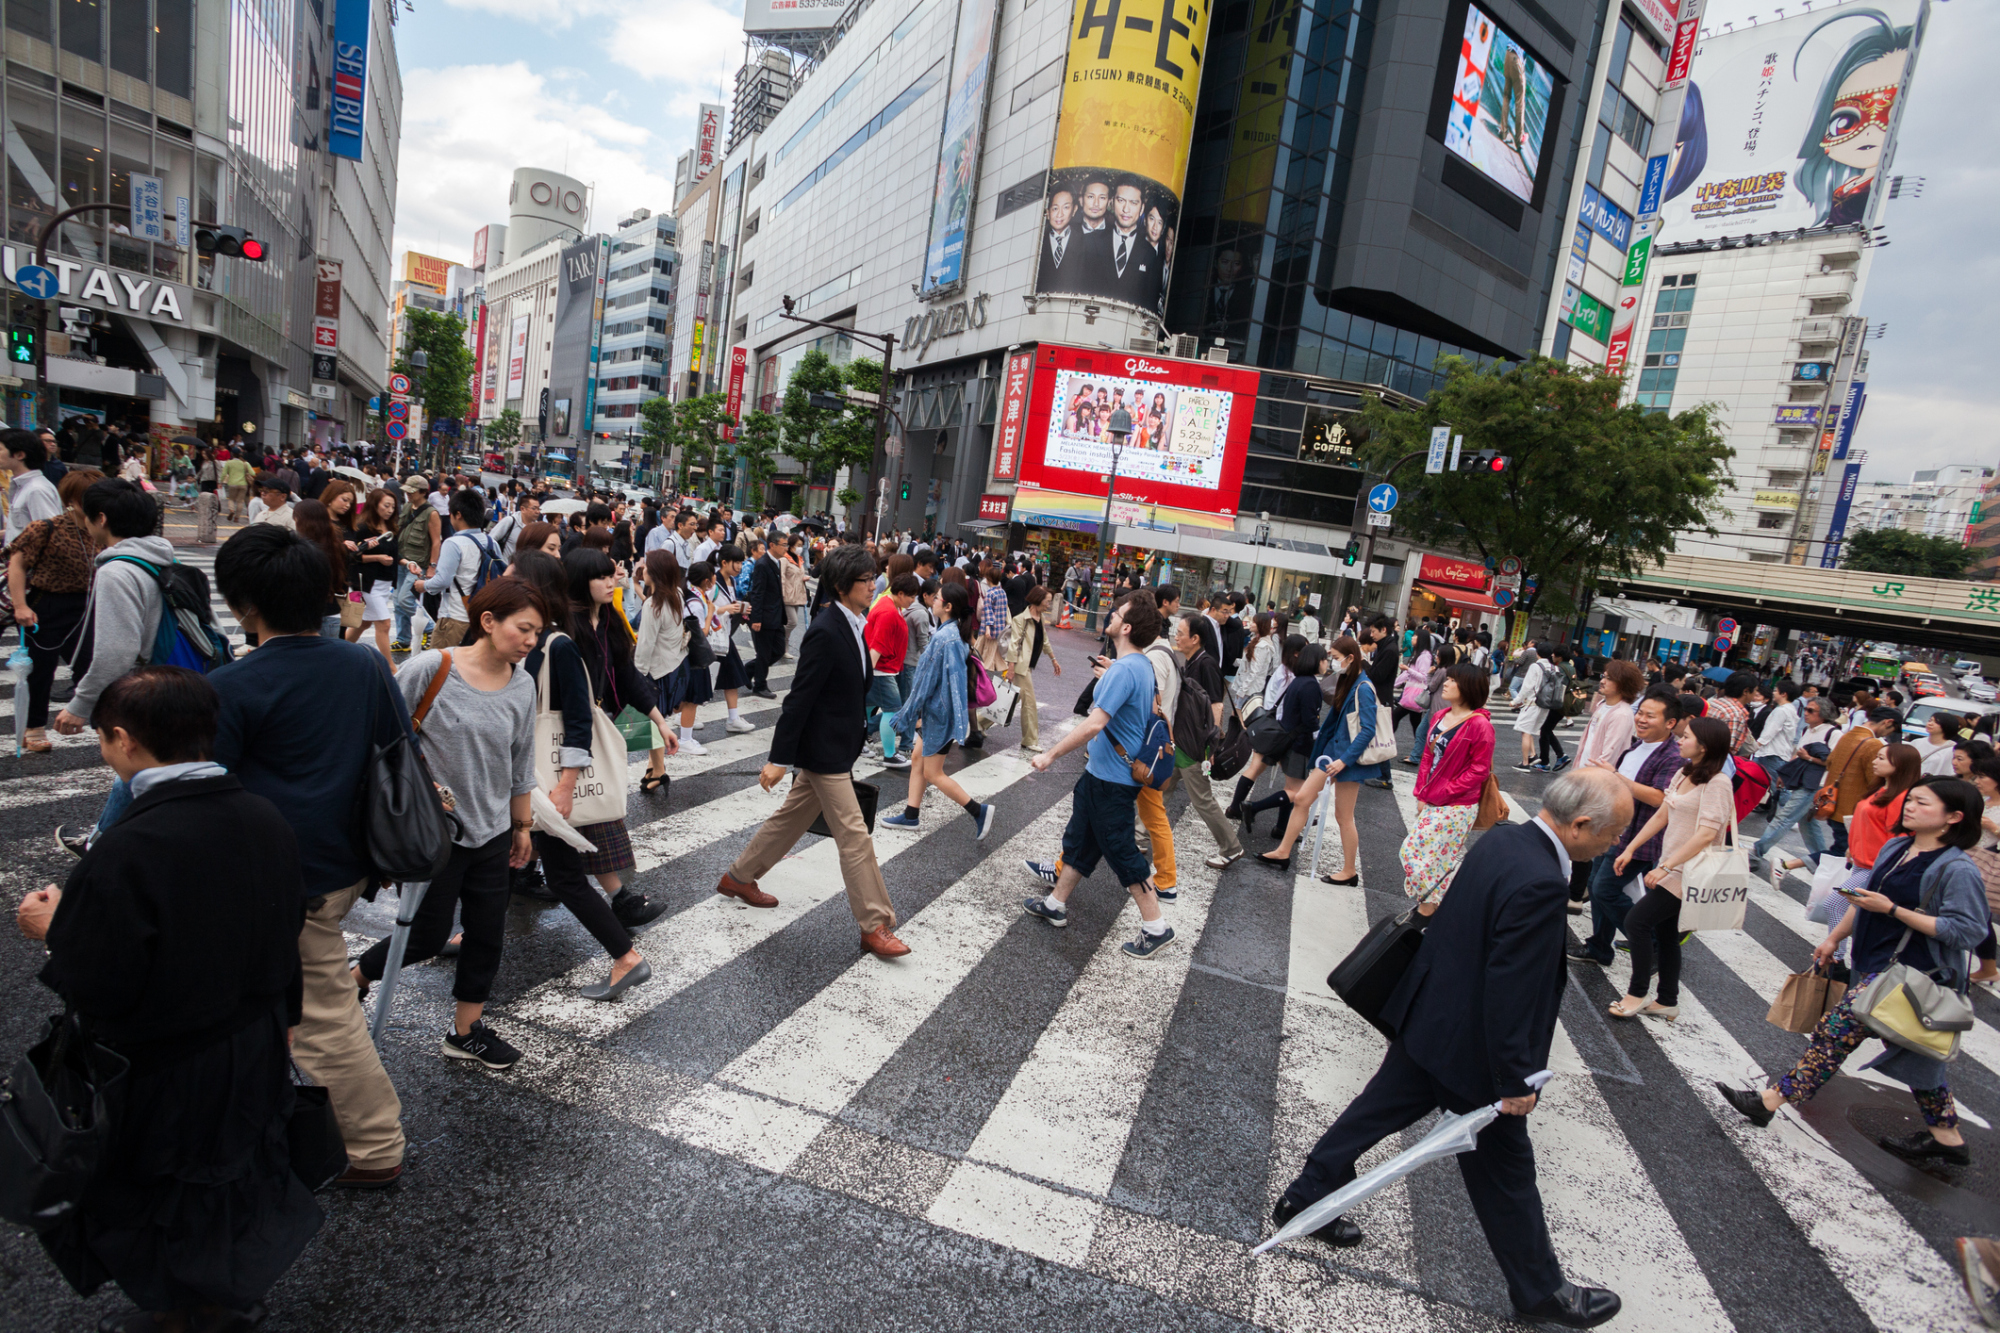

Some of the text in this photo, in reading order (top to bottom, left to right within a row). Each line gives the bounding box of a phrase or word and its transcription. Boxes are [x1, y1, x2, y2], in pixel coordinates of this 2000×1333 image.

[1671, 34, 1692, 80] アイフル
[333, 40, 364, 139] SEIBU
[1126, 70, 1170, 94] 東京競馬場
[698, 110, 718, 166] 大和証券
[1643, 159, 1663, 212] レオパレス21
[1696, 171, 1788, 202] 中森明菜
[144, 180, 160, 237] 渋谷駅前
[1581, 194, 1627, 243] レオパレス21
[418, 255, 450, 275] TOWER
[566, 250, 595, 283] ZARA
[1629, 248, 1645, 278] レイク
[1576, 302, 1596, 326] レイク
[317, 329, 335, 344] 本
[1010, 357, 1029, 372] 名物
[1125, 358, 1170, 376] Glico
[1179, 404, 1217, 418] PARTY
[1842, 388, 1858, 420] MIZUHO
[998, 373, 1025, 475] 天津甘栗
[1181, 416, 1211, 430] SALE
[1179, 429, 1202, 441] 5.23
[1060, 445, 1087, 455] Fashion
[1178, 442, 1200, 453] 5.27
[1313, 442, 1353, 455] COFFEE
[1843, 473, 1858, 501] MIZUHO
[981, 500, 1008, 515] 天津甘栗
[1028, 516, 1080, 530] SANZENRI
[1872, 582, 1905, 596] JR
[572, 782, 604, 799] GURO
